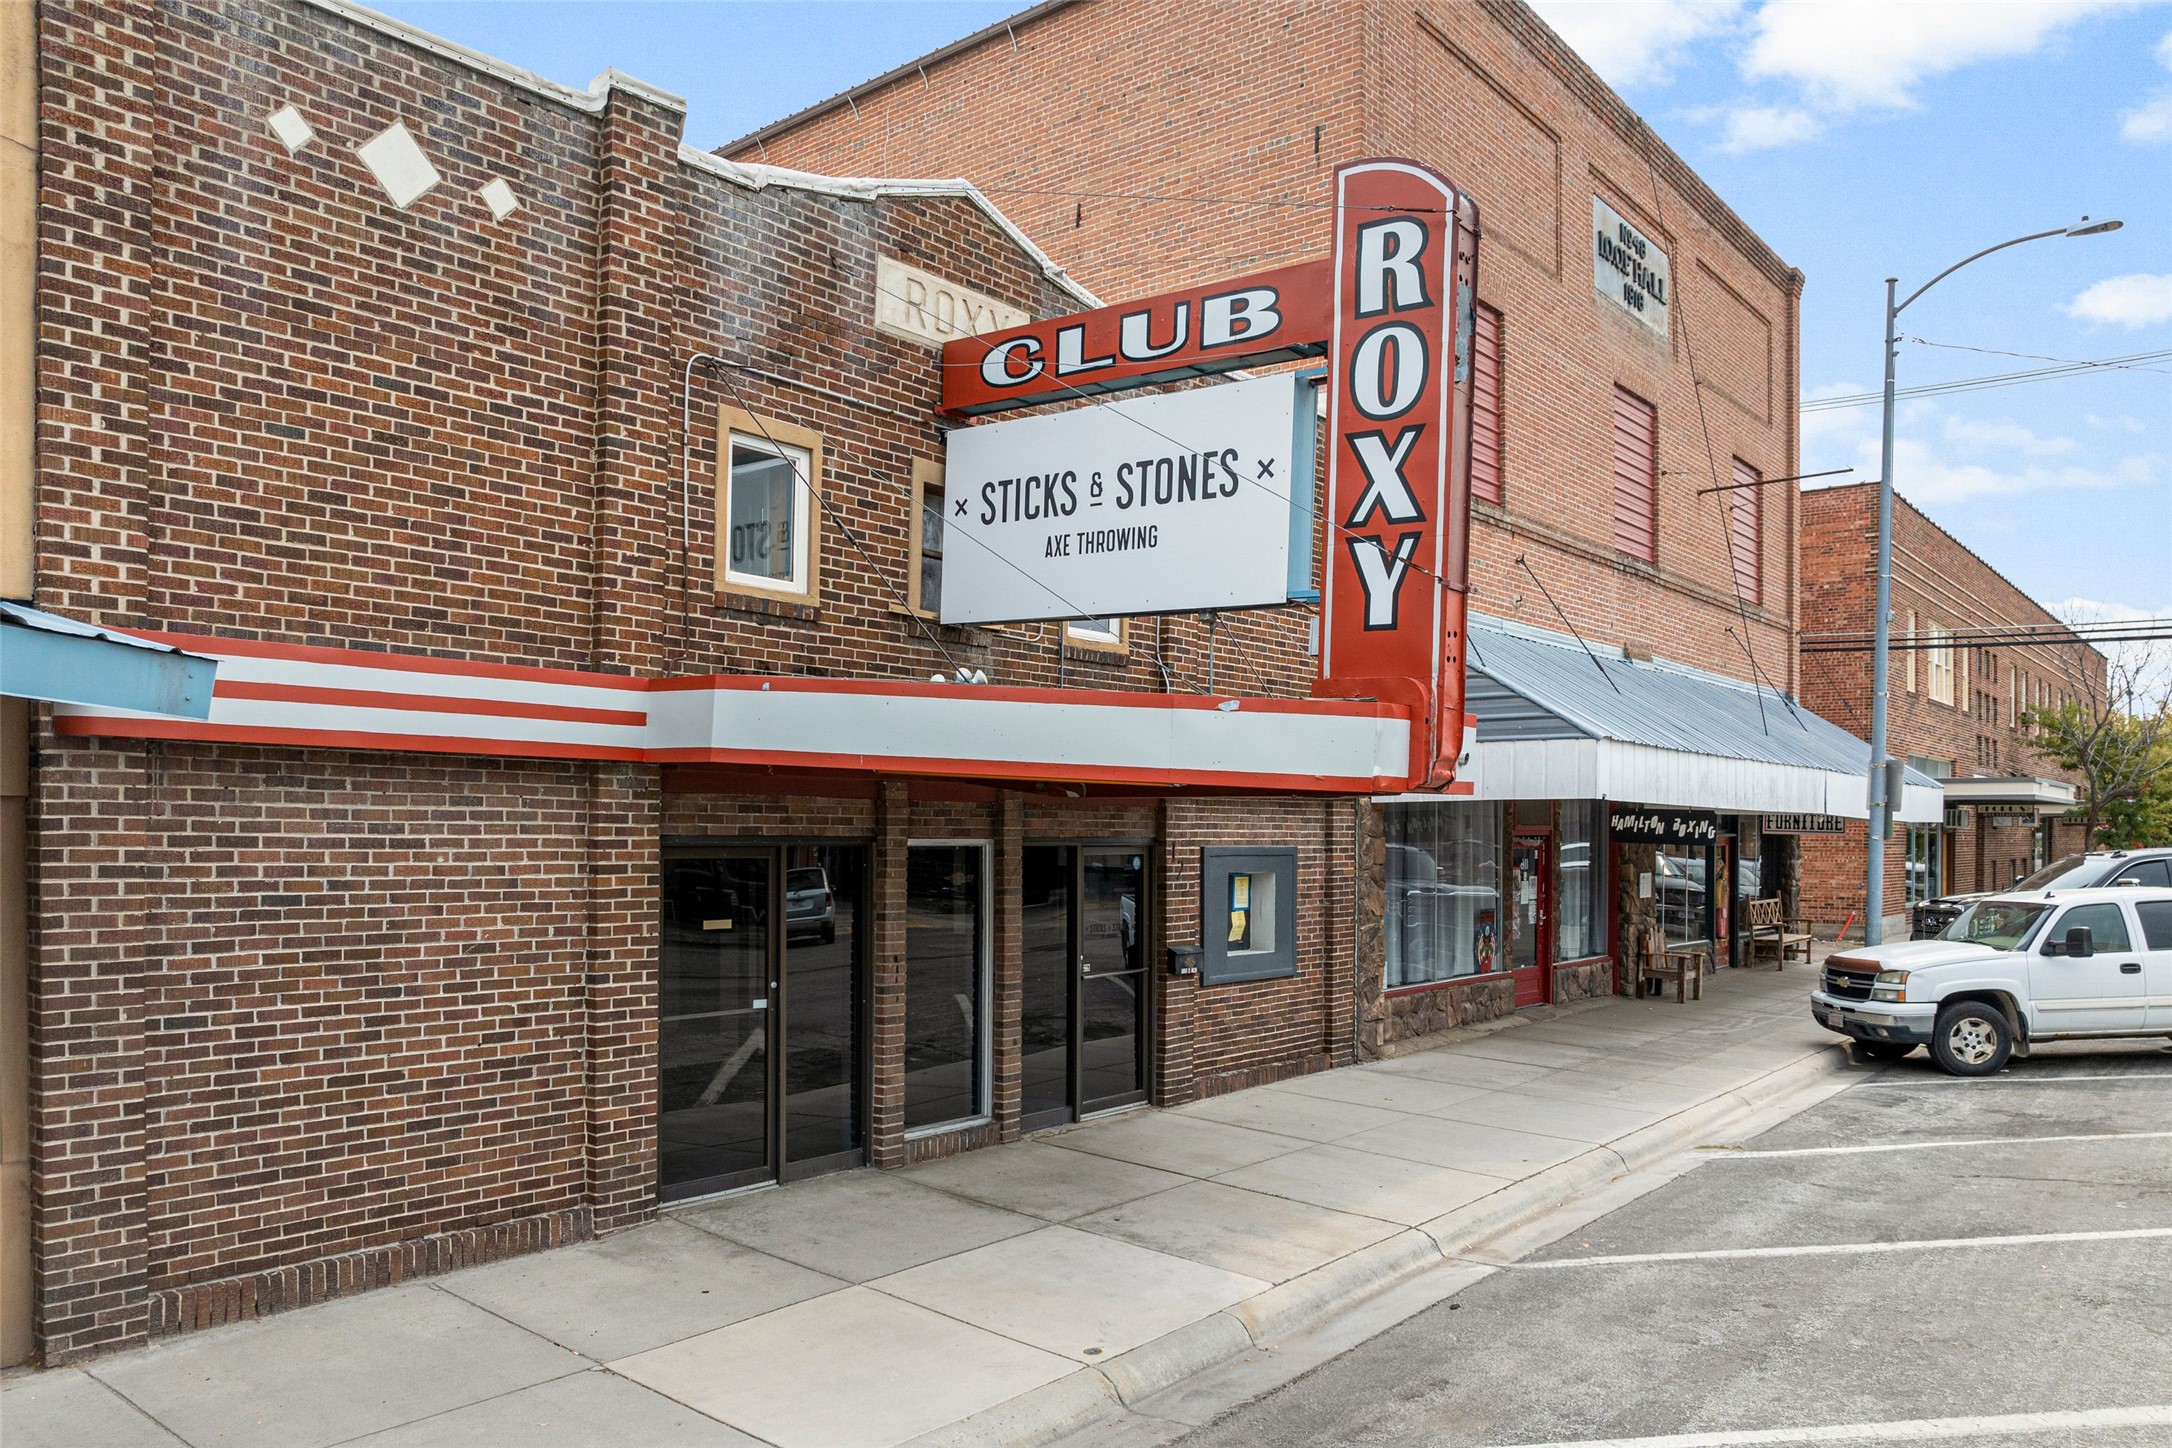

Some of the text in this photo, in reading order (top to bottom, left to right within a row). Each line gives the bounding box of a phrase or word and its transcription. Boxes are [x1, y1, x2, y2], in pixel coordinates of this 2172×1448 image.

[1632, 259, 1667, 305] HALL
[980, 285, 1282, 388] CLUB
[1344, 215, 1433, 631] ROXY
[980, 448, 1239, 526] STICKS & STONES
[1044, 524, 1158, 559] AXE THROWING
[1611, 814, 1717, 839] HAMILTON BOXING
[1766, 814, 1843, 831] FURNITURE
